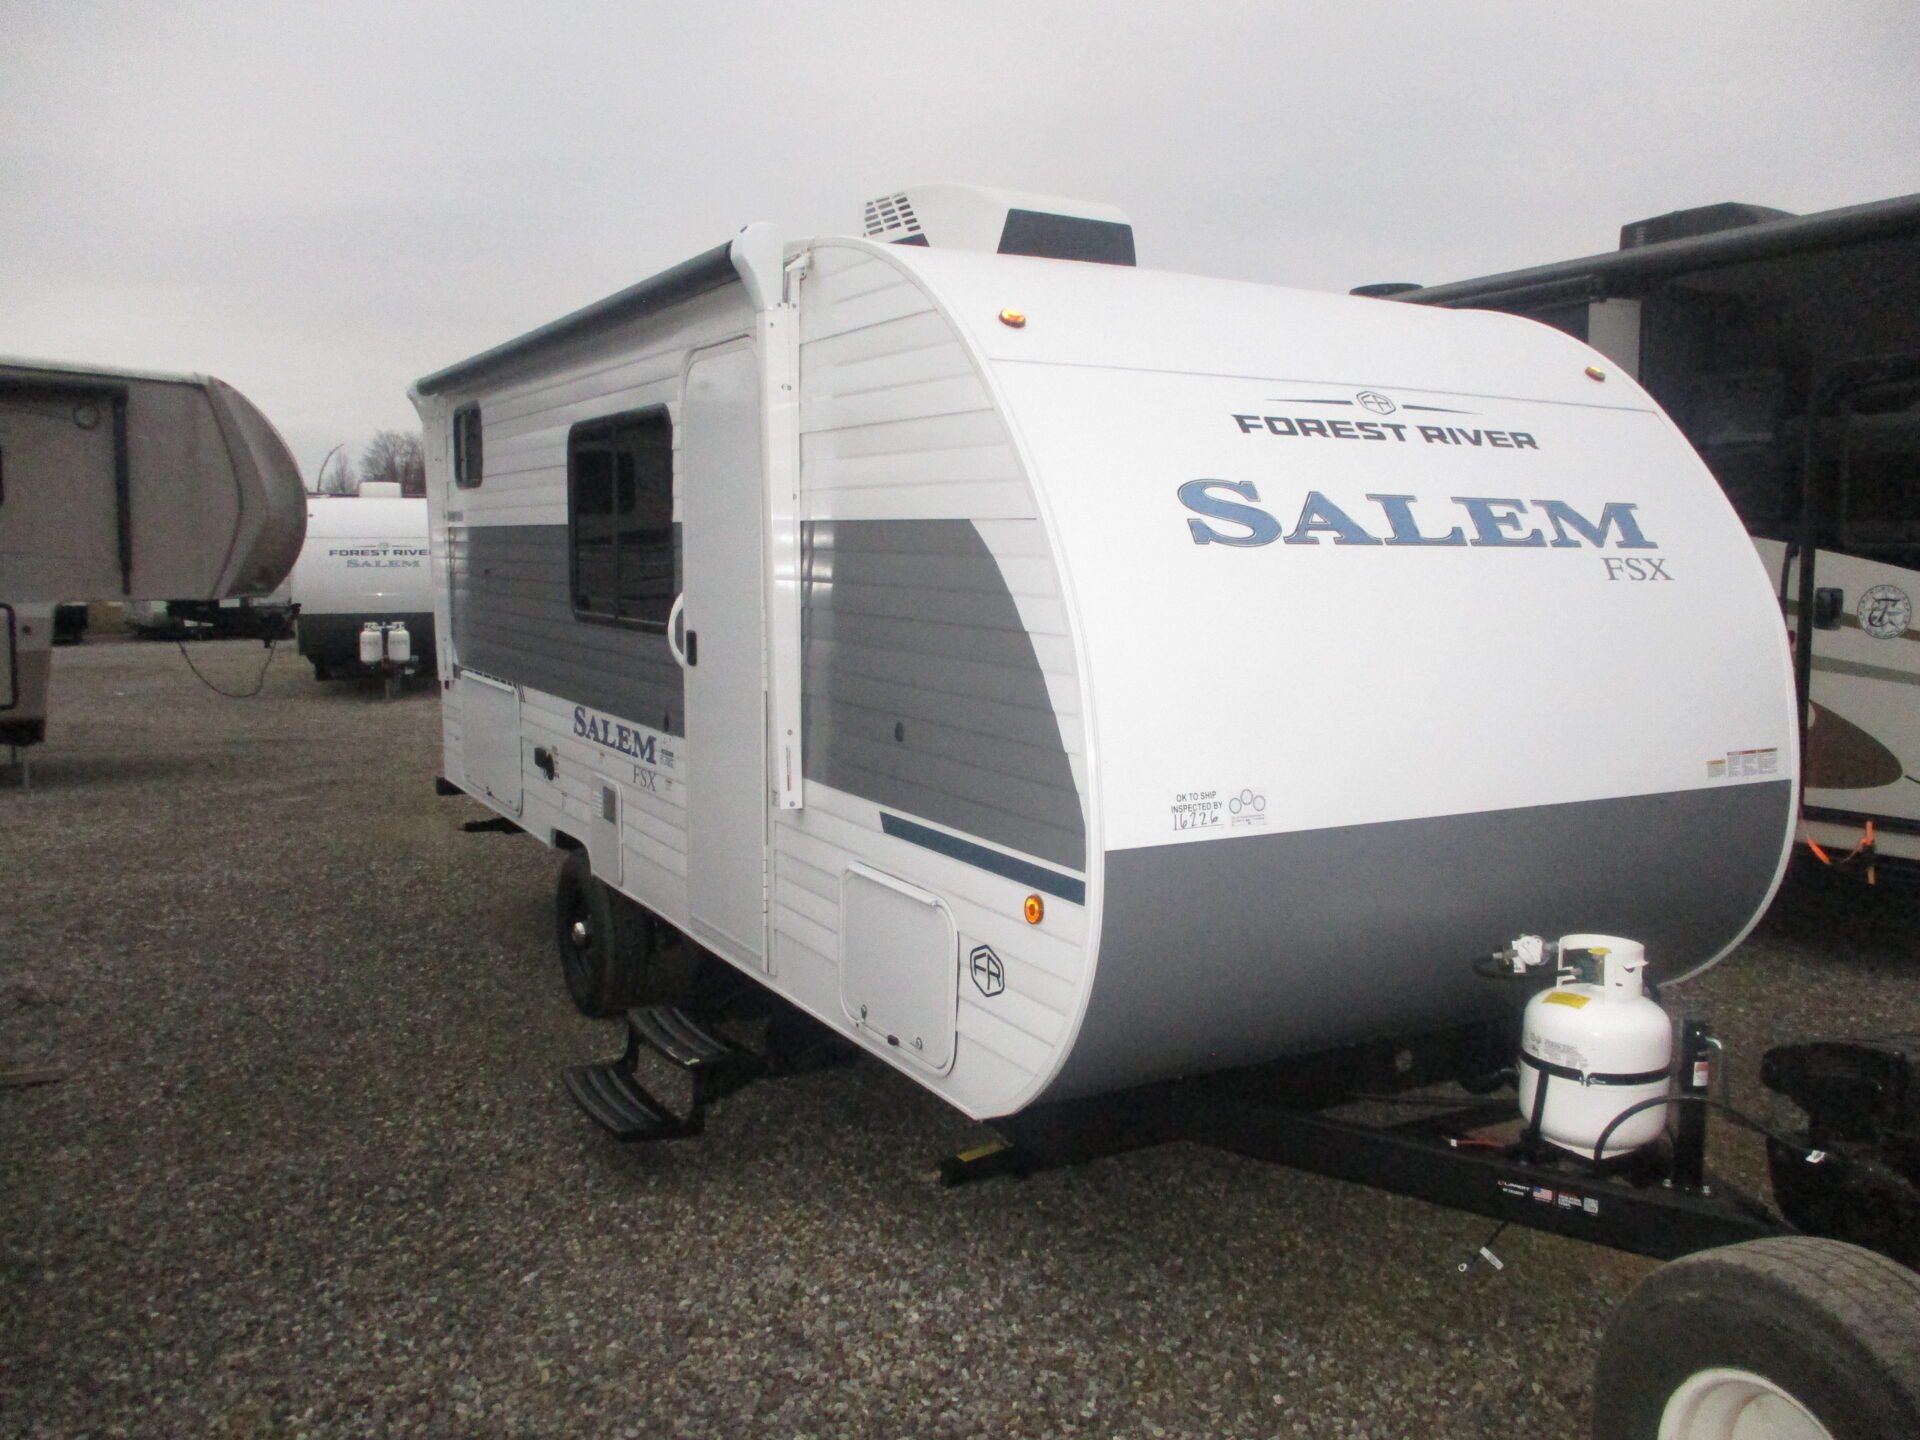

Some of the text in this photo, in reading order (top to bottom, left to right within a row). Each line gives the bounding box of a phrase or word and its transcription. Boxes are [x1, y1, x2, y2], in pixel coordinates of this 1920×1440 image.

[1231, 414, 1540, 450] FOREST RIVER
[1177, 478, 1659, 549] SALEM
[328, 549, 390, 557] FOREST
[346, 559, 421, 568] SALEM
[1601, 557, 1675, 582] FSX
[573, 705, 657, 766] SALEM
[633, 764, 657, 792] FSX
[1171, 801, 1223, 814] INSPECTED BY
[1176, 790, 1217, 802] OK TO SHIP
